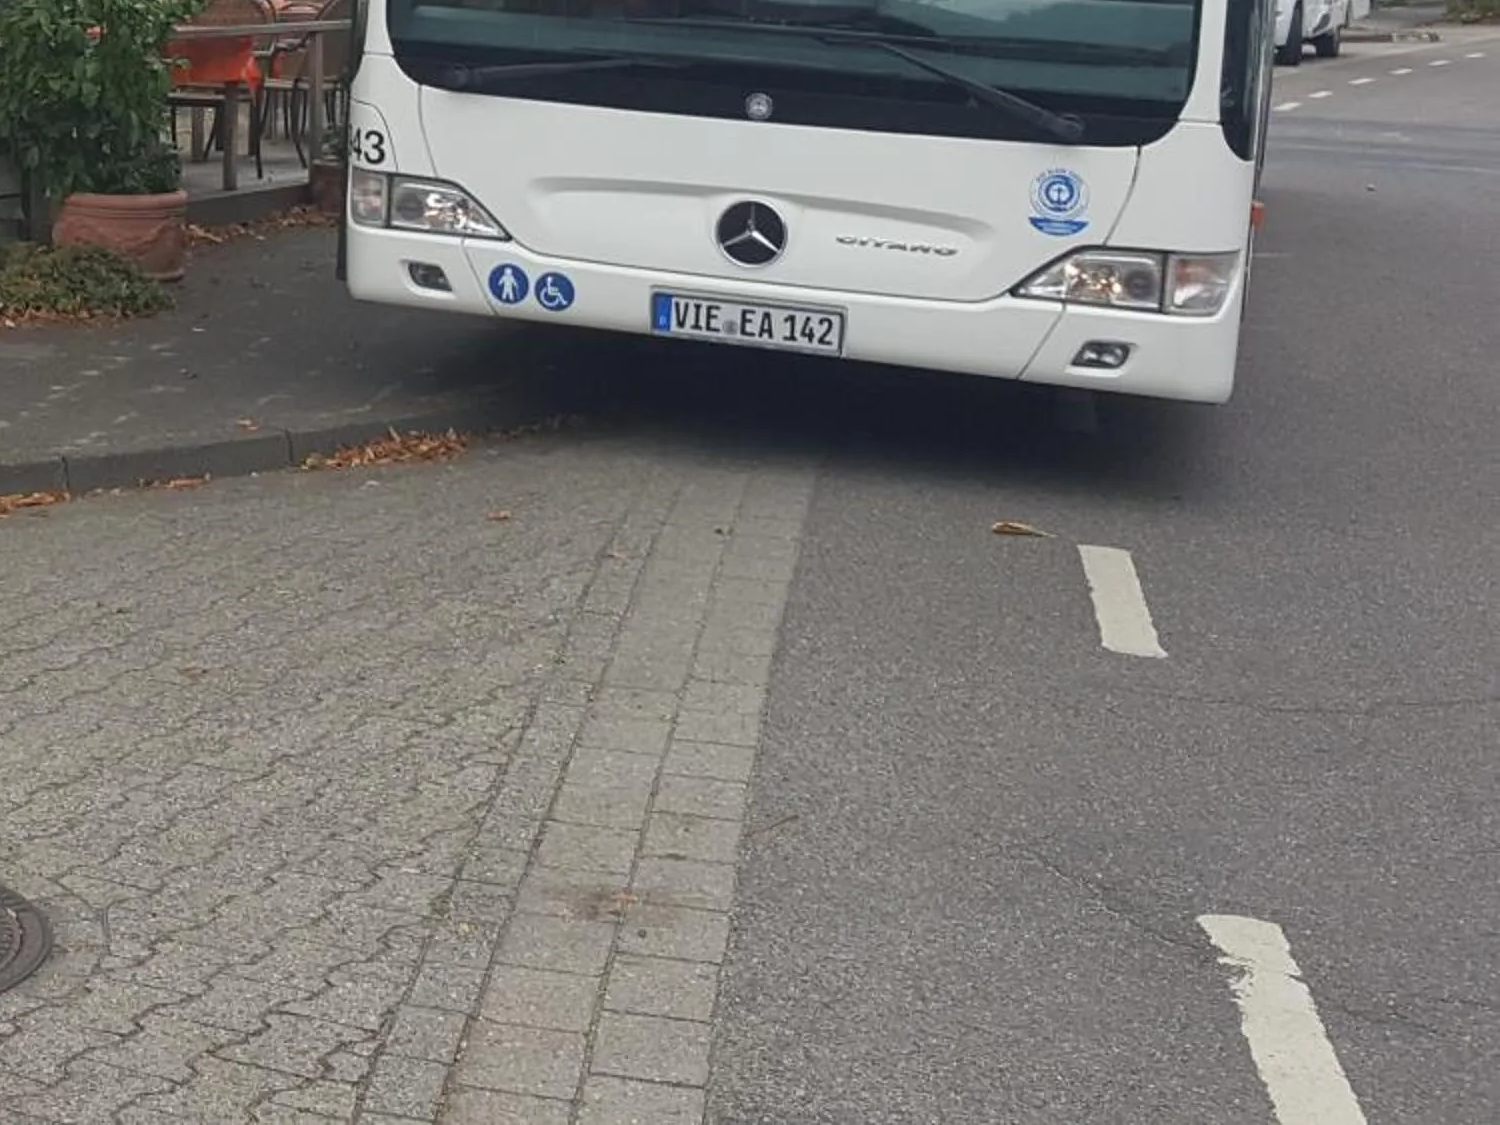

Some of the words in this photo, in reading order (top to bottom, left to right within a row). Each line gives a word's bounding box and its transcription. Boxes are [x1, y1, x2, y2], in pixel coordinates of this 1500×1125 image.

[349, 123, 385, 164] 43
[674, 301, 721, 333] VIE
[740, 309, 774, 340] EA
[782, 314, 834, 346] 142
